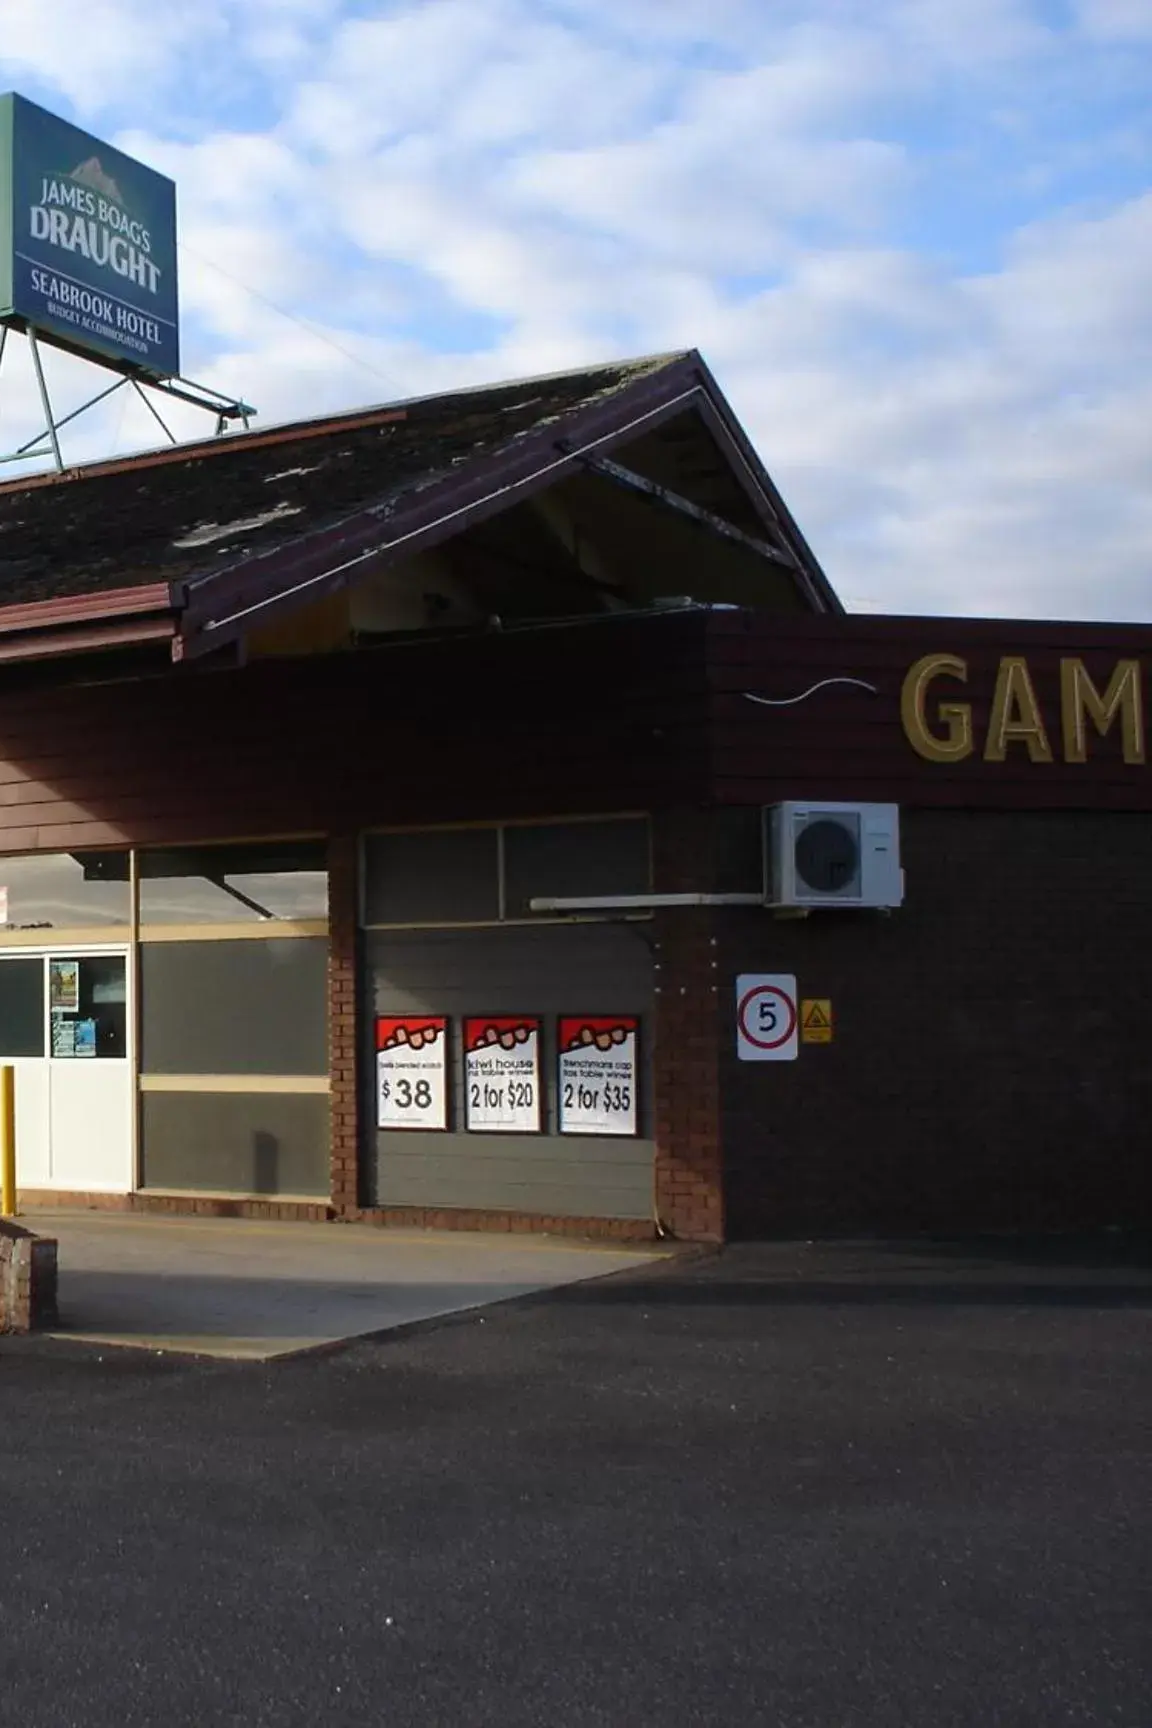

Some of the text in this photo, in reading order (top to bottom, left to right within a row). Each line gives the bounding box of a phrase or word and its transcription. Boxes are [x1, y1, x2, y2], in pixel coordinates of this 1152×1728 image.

[41, 178, 151, 253] JAMES BOAG'S
[29, 206, 162, 295] DRAUGHT
[31, 268, 163, 345] SEABROOK HOTEL
[900, 653, 1145, 764] GAM
[758, 1001, 778, 1033] 5
[468, 1058, 534, 1069] kiwi house
[471, 1079, 534, 1110] 2 for $20
[564, 1081, 631, 1114] 2 for $35
